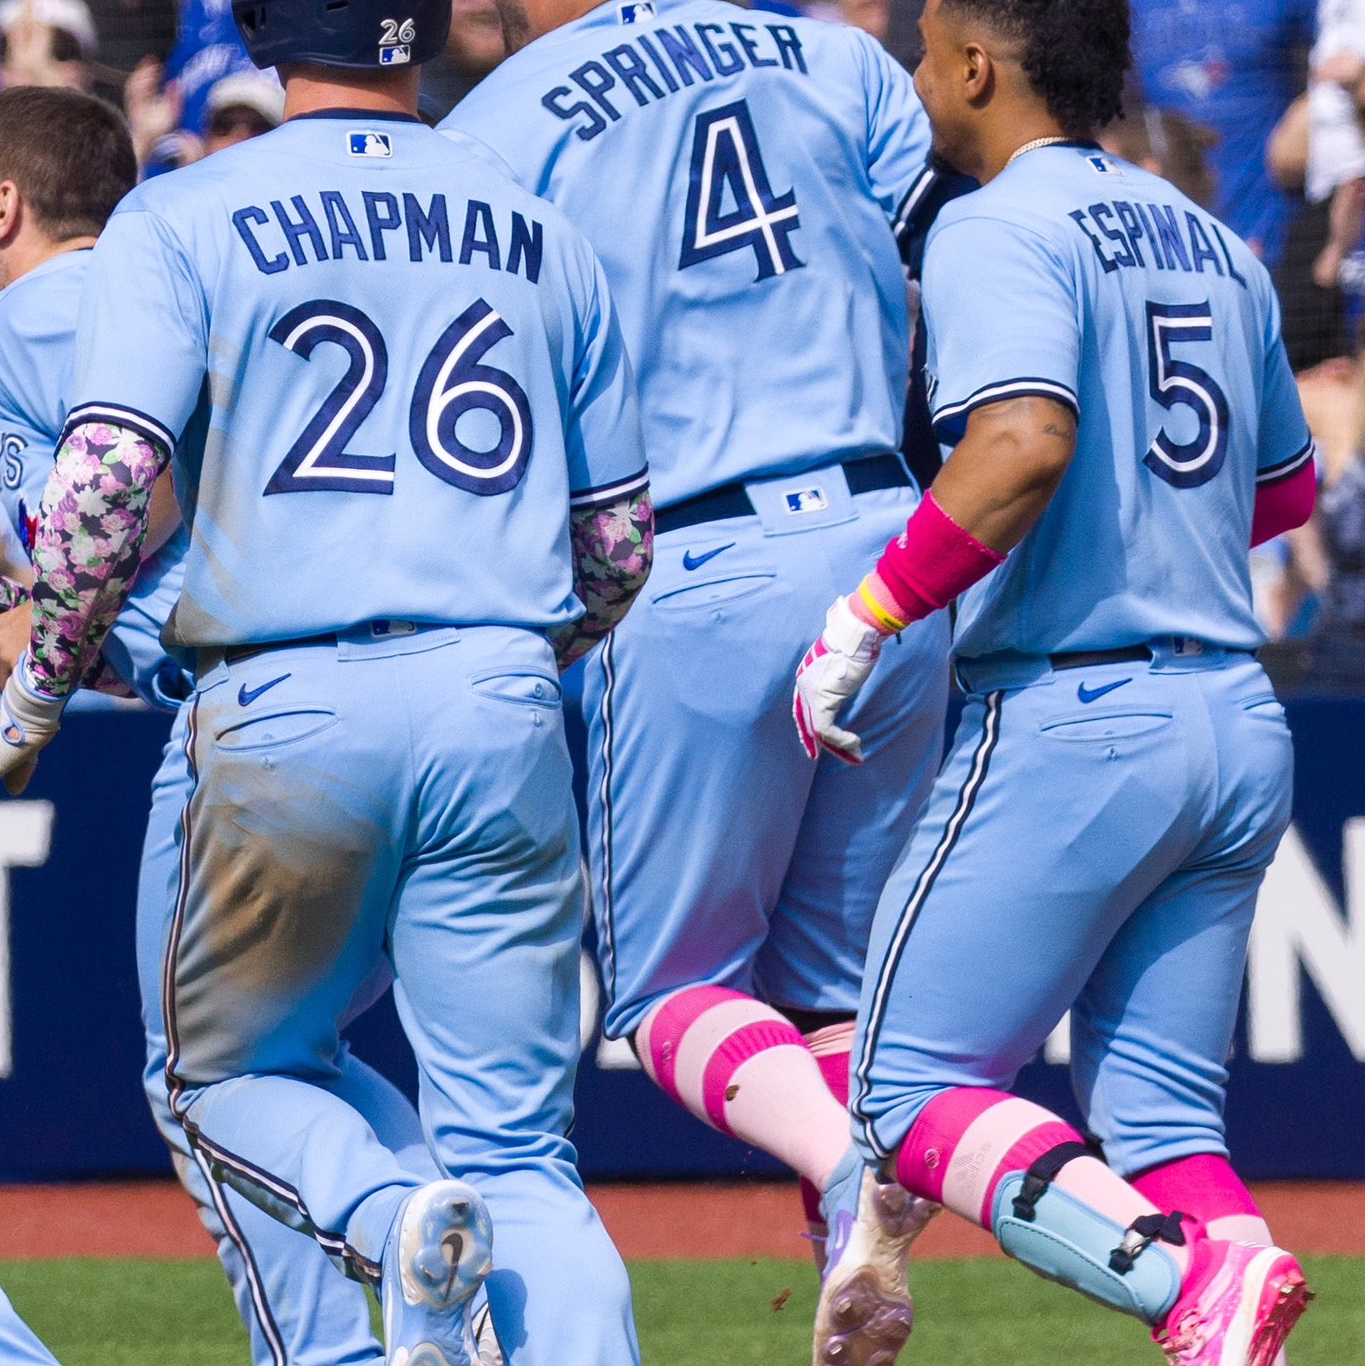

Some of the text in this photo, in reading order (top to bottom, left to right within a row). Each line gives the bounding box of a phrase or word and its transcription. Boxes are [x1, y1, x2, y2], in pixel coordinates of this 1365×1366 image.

[379, 18, 415, 46] 26
[543, 24, 807, 140] SPRINGER
[233, 191, 543, 285] CHAPMAN
[679, 99, 805, 282] 4
[1070, 201, 1248, 288] ESPINAL
[264, 298, 533, 496] 26
[1144, 301, 1229, 488] 5
